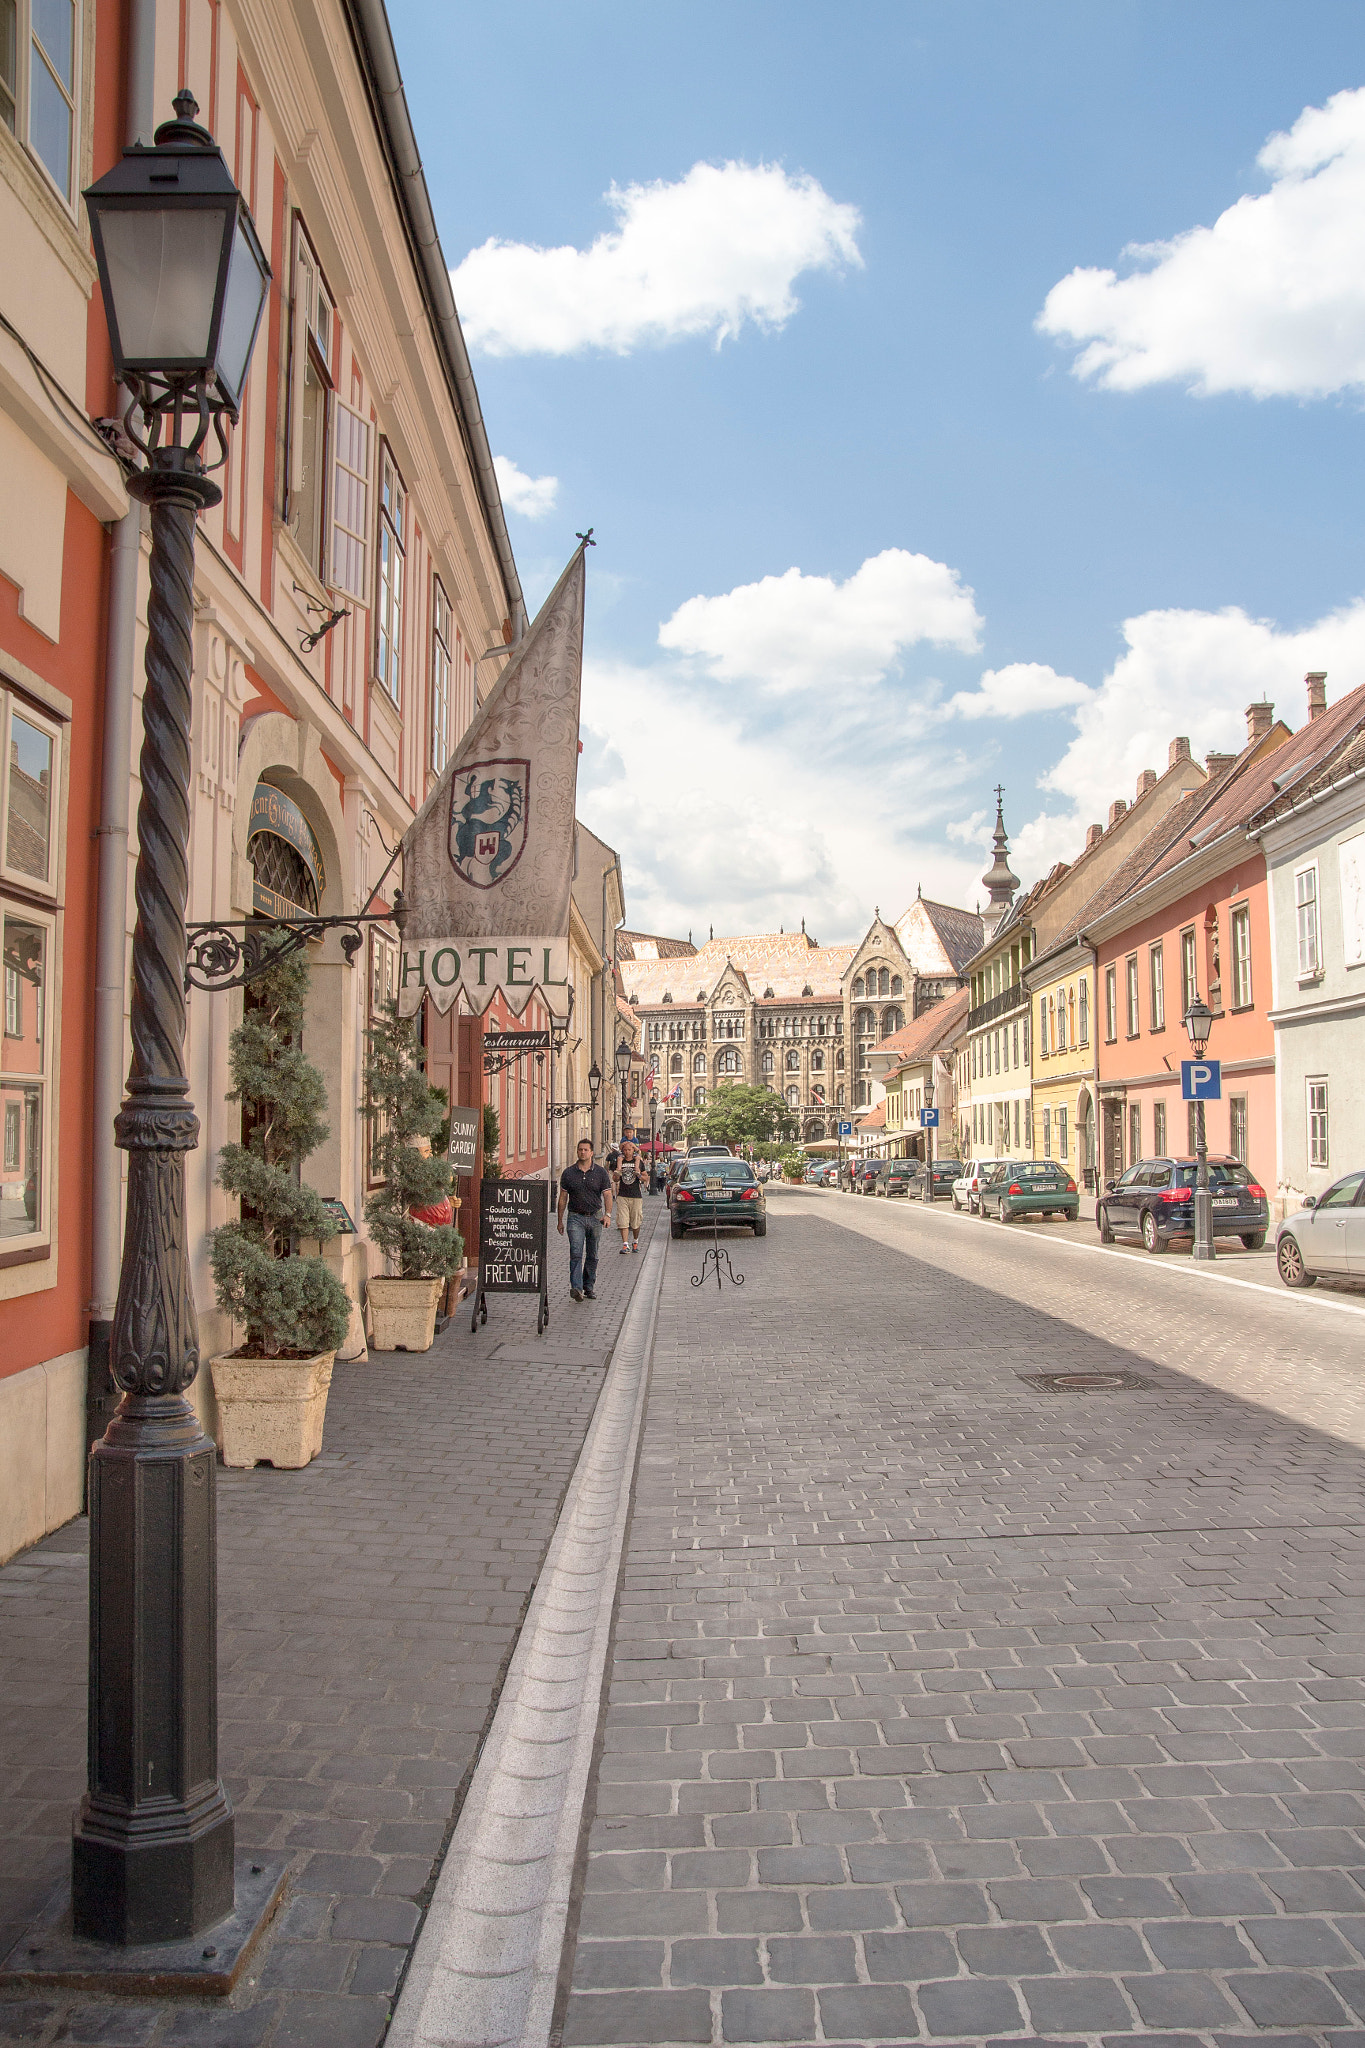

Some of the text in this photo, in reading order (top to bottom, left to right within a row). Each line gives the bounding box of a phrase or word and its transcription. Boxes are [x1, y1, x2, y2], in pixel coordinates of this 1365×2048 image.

[250, 796, 268, 820] zent
[401, 947, 568, 988] HOTEL
[1190, 1065, 1211, 1095] P
[924, 1111, 935, 1125] P
[453, 1121, 476, 1137] SUNNY
[841, 1123, 849, 1133] P
[450, 1140, 476, 1155] GARDEN
[497, 1188, 530, 1204] MENU
[517, 1208, 532, 1216] soup
[494, 1247, 523, 1262] 2700
[485, 1264, 539, 1287] FREE WIFI!
